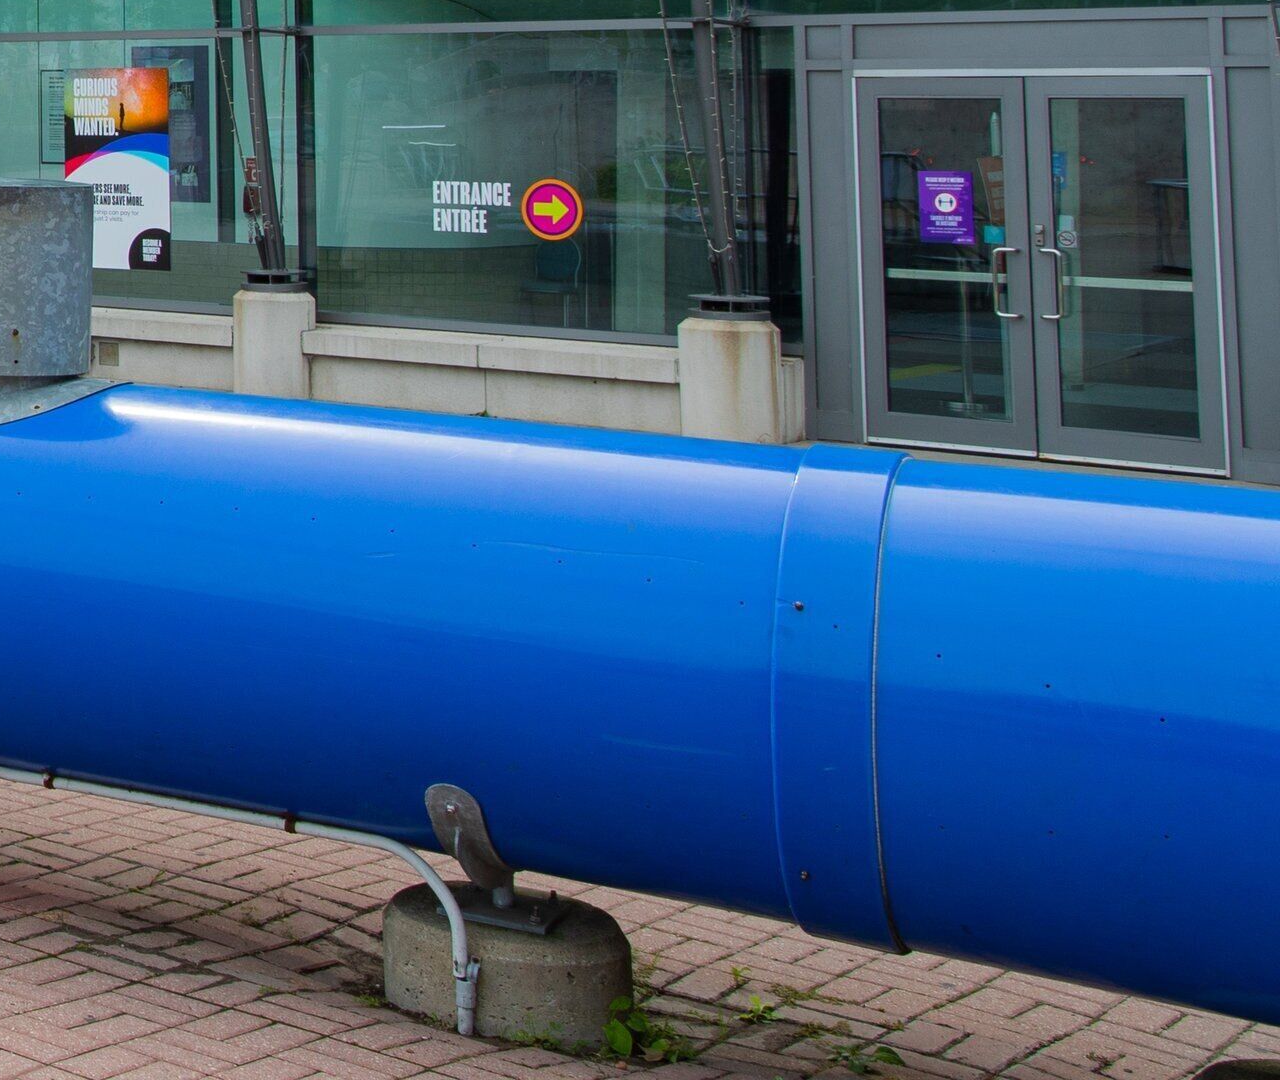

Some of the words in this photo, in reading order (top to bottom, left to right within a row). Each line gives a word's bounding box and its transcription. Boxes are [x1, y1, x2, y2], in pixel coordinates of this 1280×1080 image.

[73, 77, 118, 97] CURIOUS
[73, 97, 109, 117] MINDS
[73, 117, 119, 136] WANTED.
[103, 183, 113, 193] SEE
[113, 183, 131, 194] MORE,
[432, 180, 512, 207] ENTRANCE
[100, 195, 111, 205] AND
[112, 195, 126, 206] SAVE
[126, 196, 144, 206] MORE.
[433, 206, 488, 233] ENTRÉE
